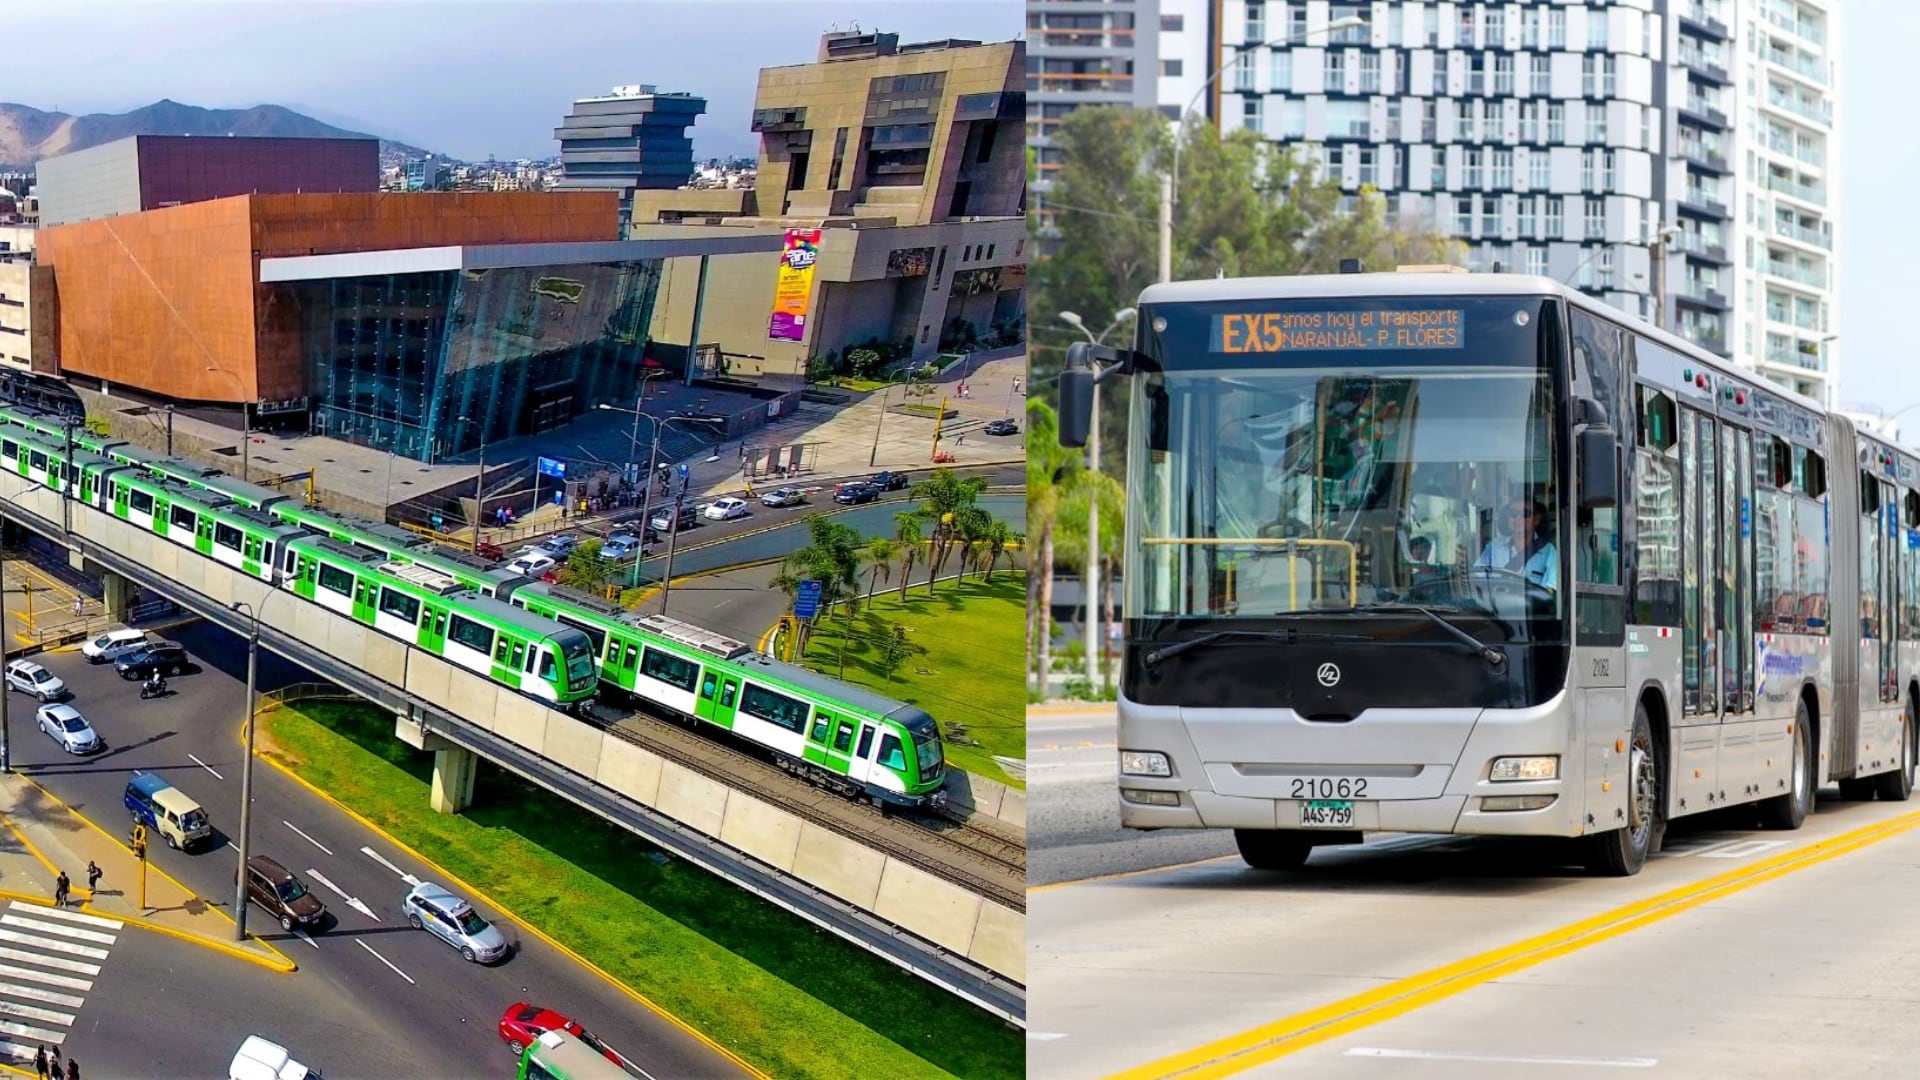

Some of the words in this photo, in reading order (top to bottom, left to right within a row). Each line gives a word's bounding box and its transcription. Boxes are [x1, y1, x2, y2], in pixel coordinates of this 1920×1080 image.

[1327, 311, 1355, 330] hoy
[1360, 311, 1374, 327] el
[1223, 314, 1283, 352] EX5
[1397, 328, 1457, 347] FLORES
[1291, 778, 1368, 798] 21062
[1303, 807, 1352, 823] A4S-759
